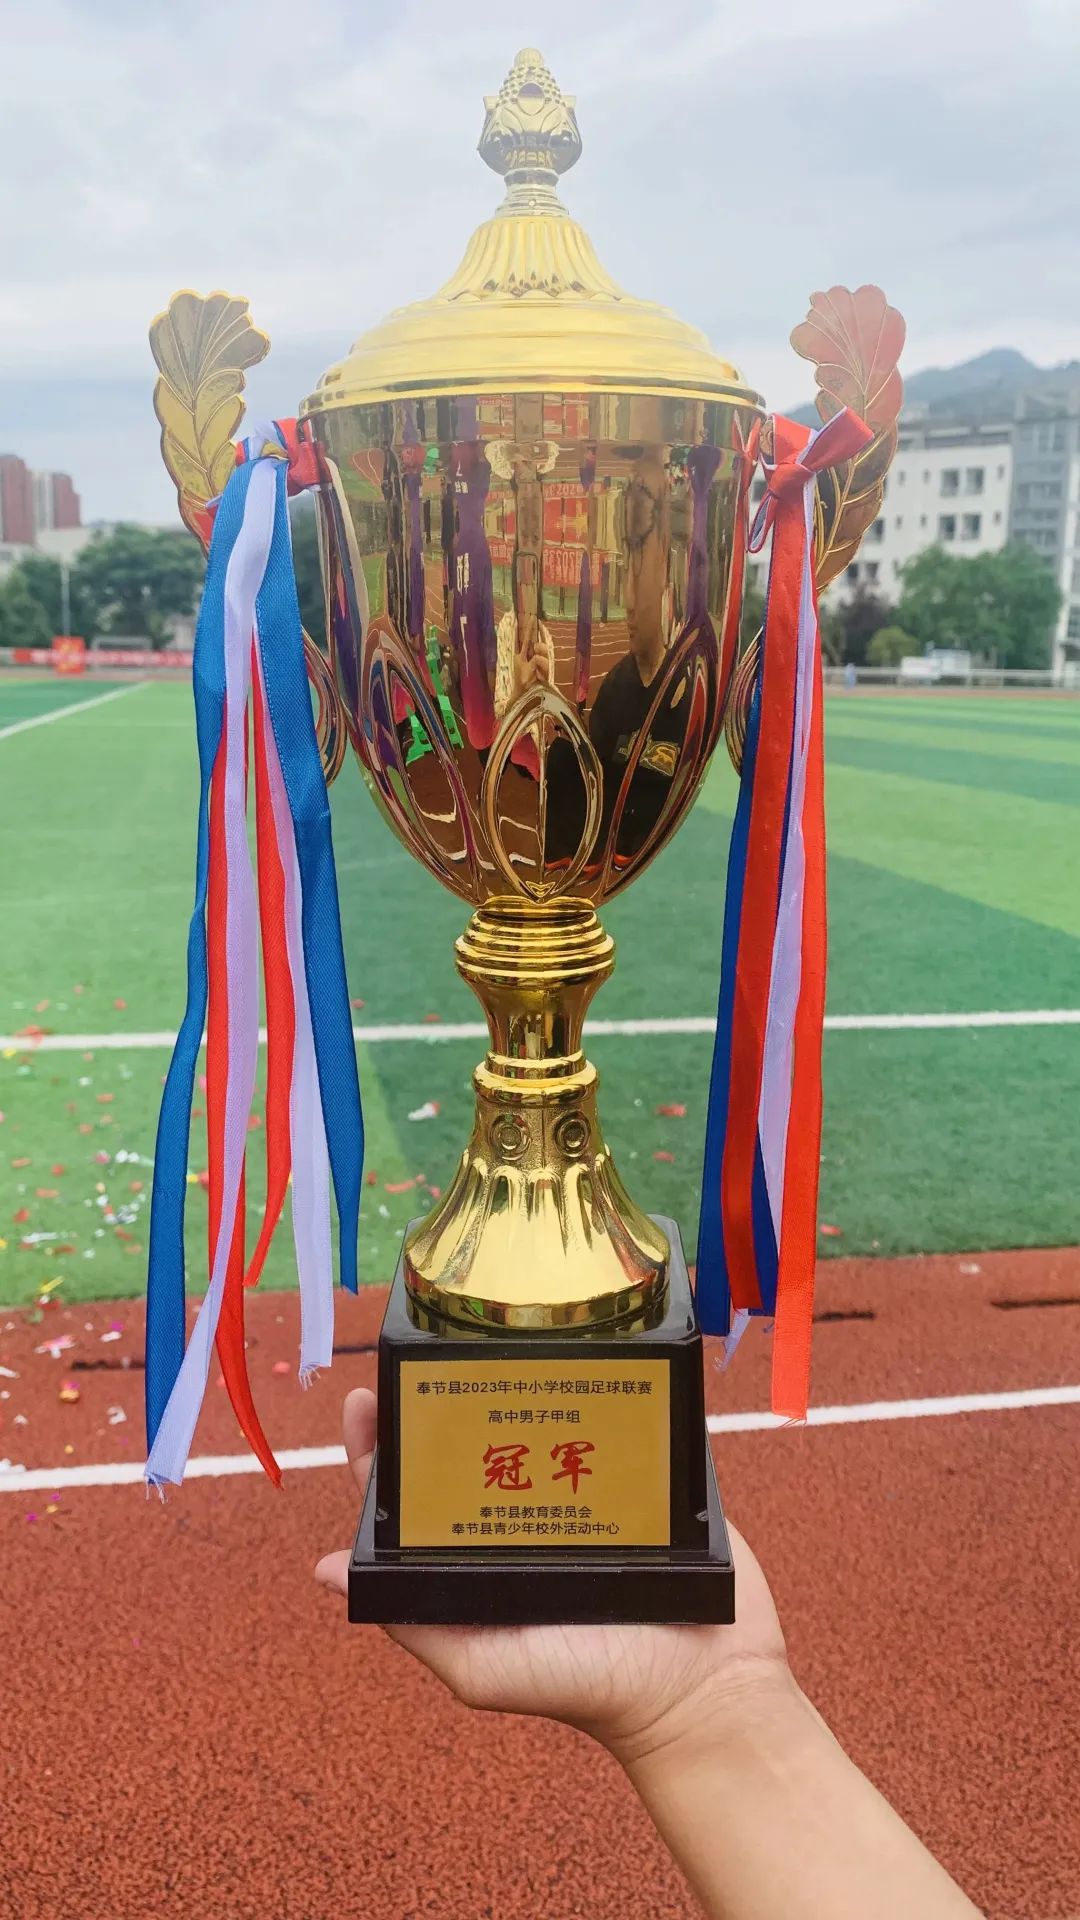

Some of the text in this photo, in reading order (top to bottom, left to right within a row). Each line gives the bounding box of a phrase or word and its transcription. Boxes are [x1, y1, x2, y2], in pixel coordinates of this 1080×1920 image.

[416, 1380, 652, 1395] 奉节县2023年中小学校园足球联赛
[488, 1409, 581, 1424] 高中男子甲组
[482, 1441, 595, 1495] 冠军
[479, 1506, 593, 1519] 奉节县教育委员会
[451, 1522, 620, 1536] 奉节县青少年校外活动中心
